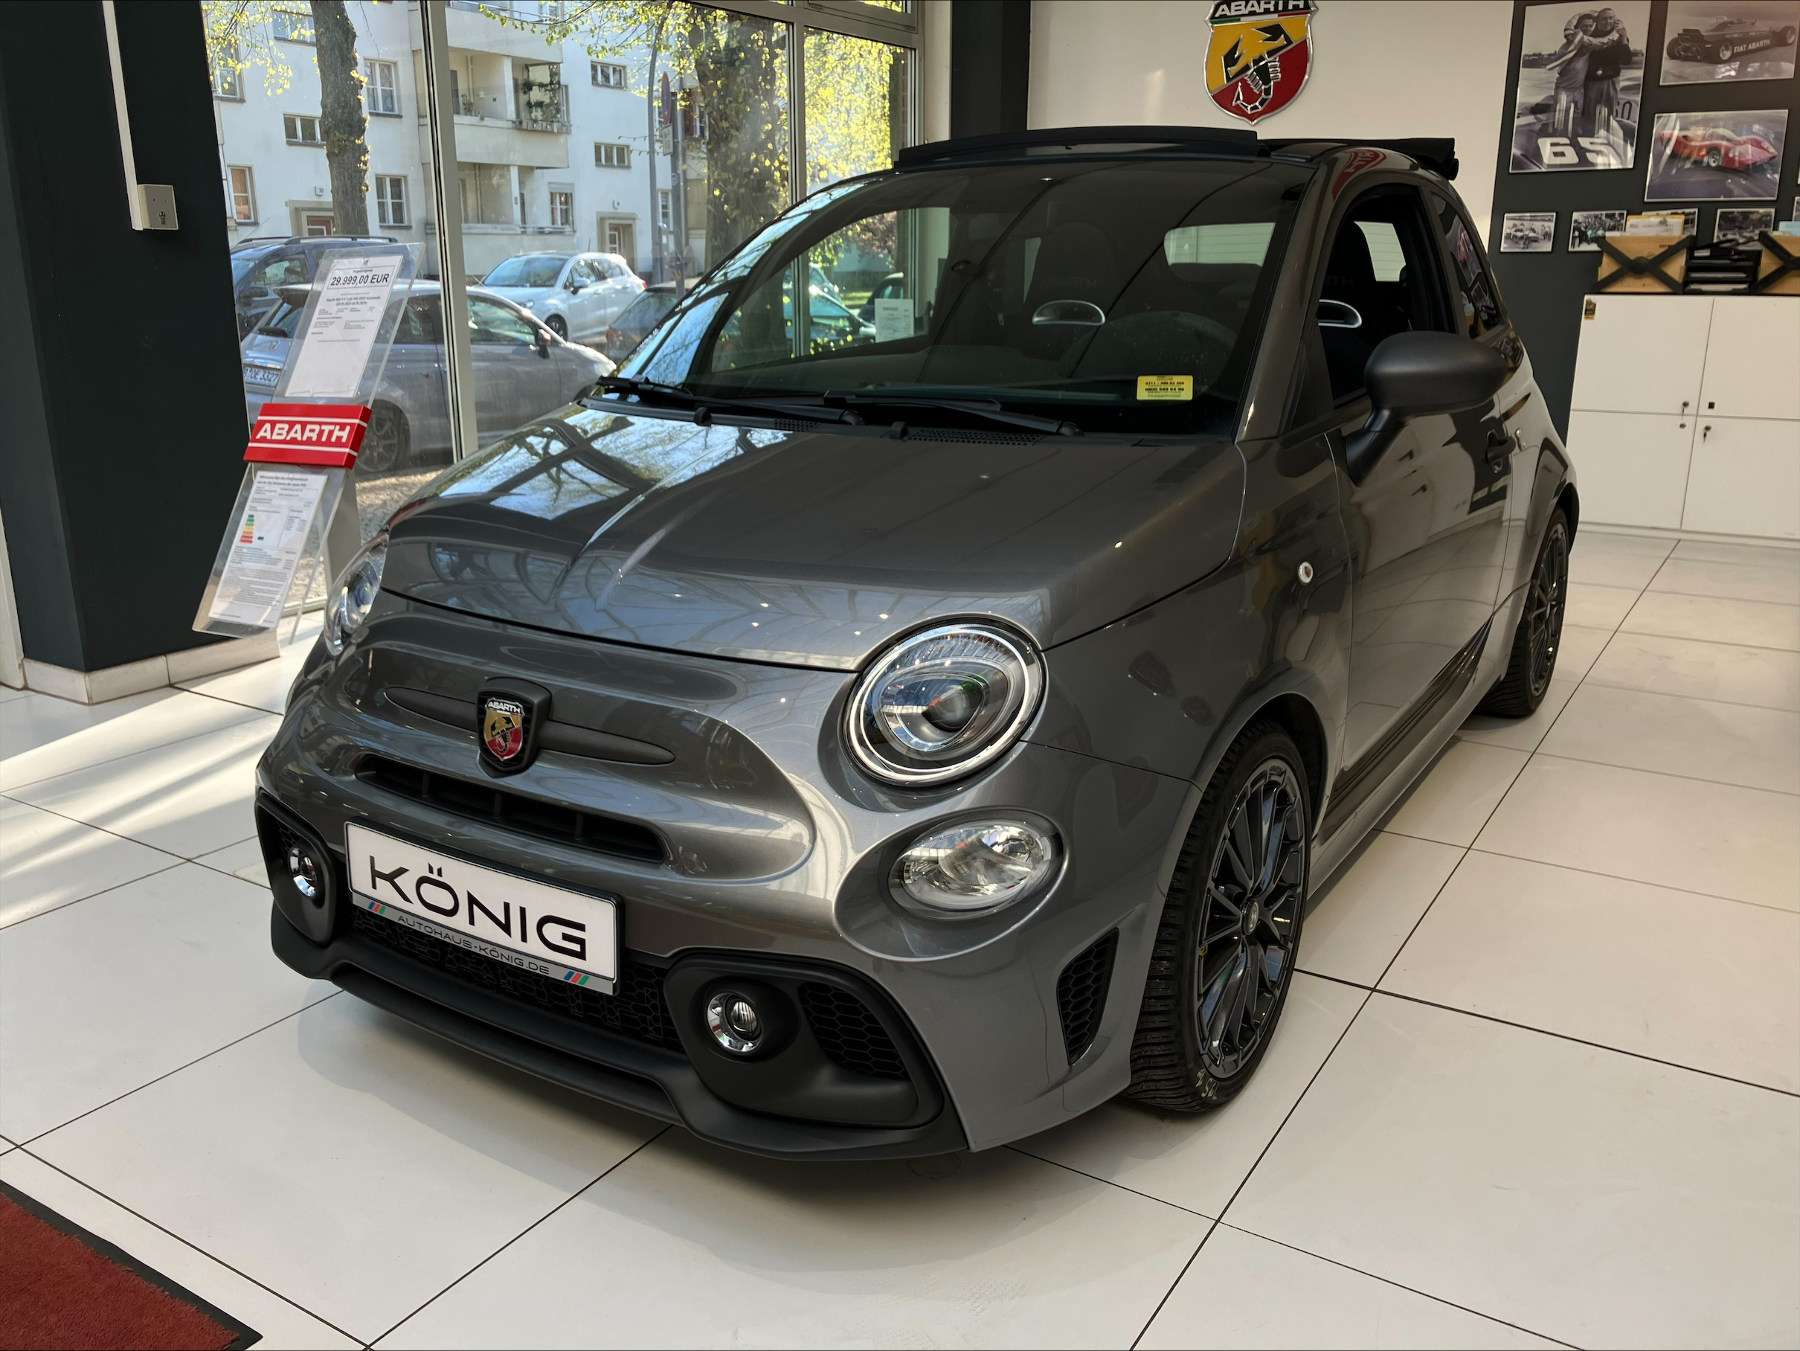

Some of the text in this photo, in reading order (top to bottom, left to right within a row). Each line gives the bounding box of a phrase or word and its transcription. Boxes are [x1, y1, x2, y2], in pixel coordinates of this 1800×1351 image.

[1214, 0, 1304, 17] ABARTH
[330, 273, 390, 287] 29.999,00 EUR
[255, 422, 352, 443] ABARTH
[488, 701, 521, 714] ABARTH
[369, 855, 587, 961] KÖNIG
